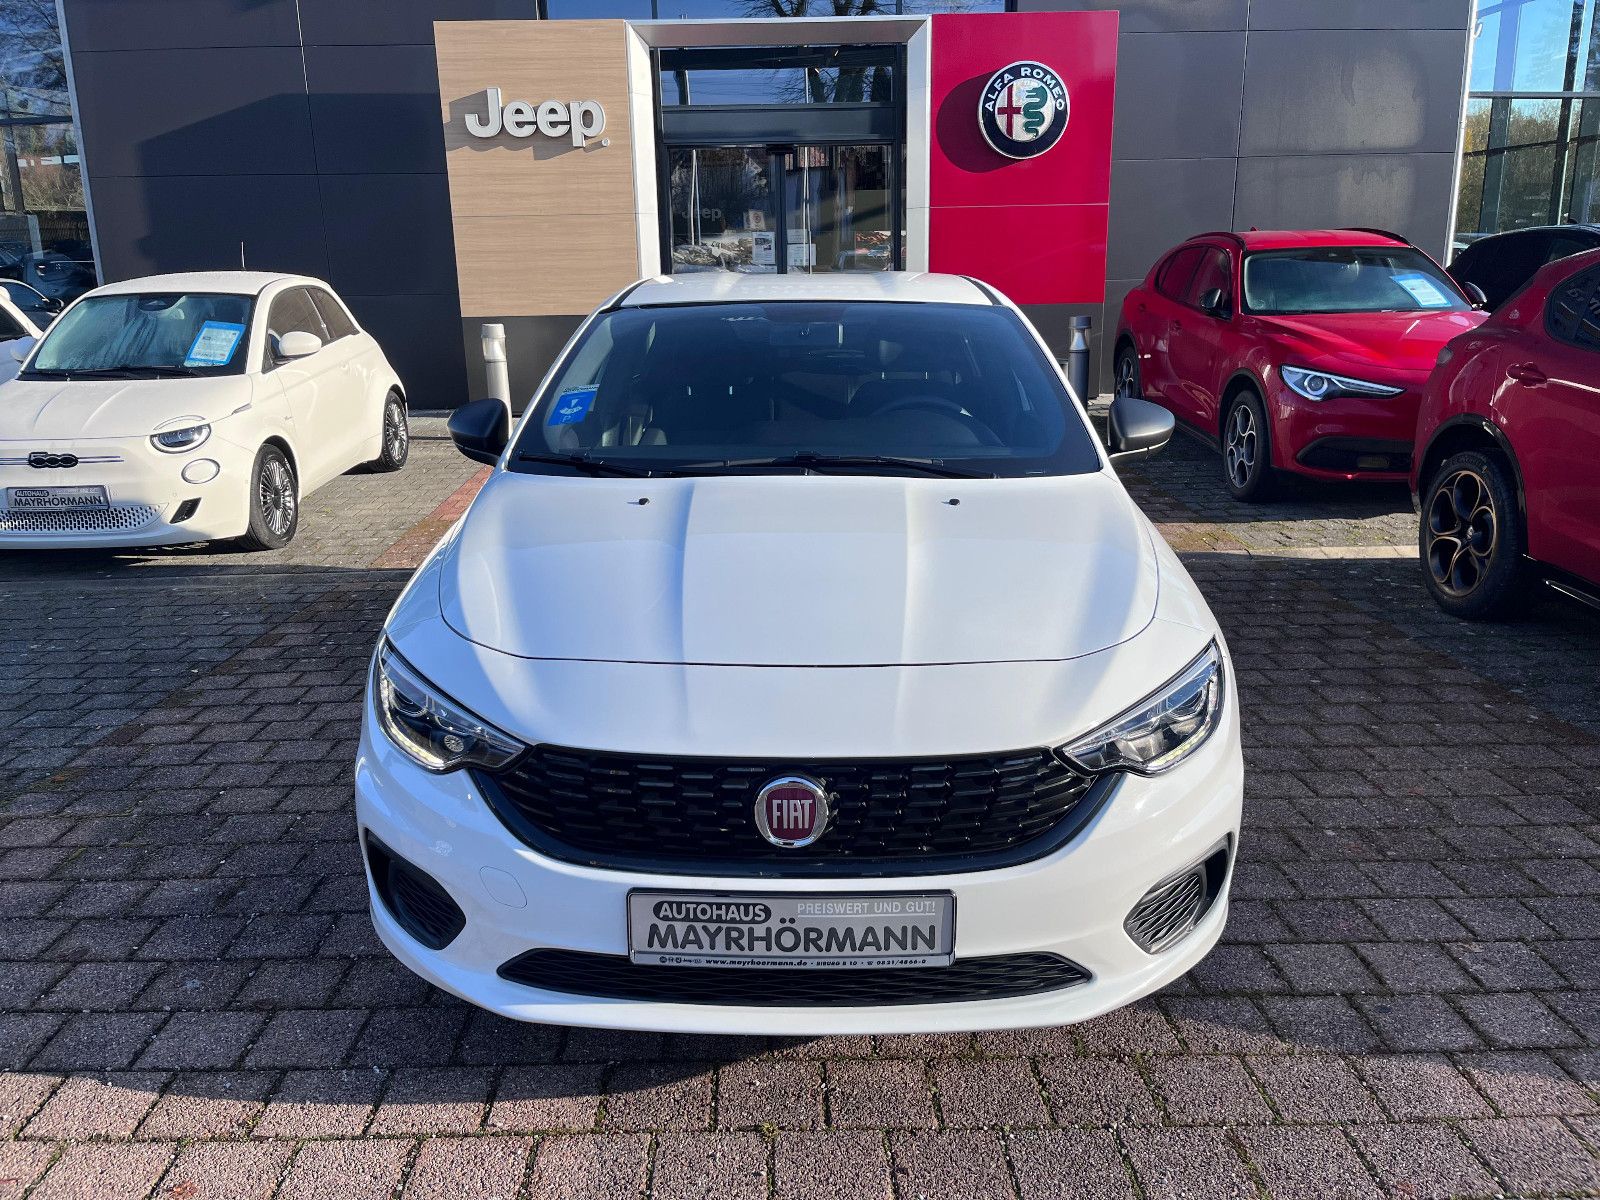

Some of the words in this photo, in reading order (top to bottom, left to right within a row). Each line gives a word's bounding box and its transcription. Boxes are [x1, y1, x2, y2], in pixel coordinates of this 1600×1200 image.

[985, 73, 1014, 111] ALFA
[1020, 67, 1065, 111] ROMEO
[464, 87, 606, 148] Jeep
[29, 451, 79, 469] 500
[14, 494, 102, 507] MAYRHÖRMANN
[772, 799, 813, 829] FIAT
[659, 903, 766, 921] AUTOHAUS
[797, 902, 870, 915] PREISWERT
[874, 901, 902, 914] UND
[905, 901, 936, 913] GUT!
[647, 917, 936, 953] MAYRHÖRMANN
[705, 958, 808, 967] www.mayrhoermann.de
